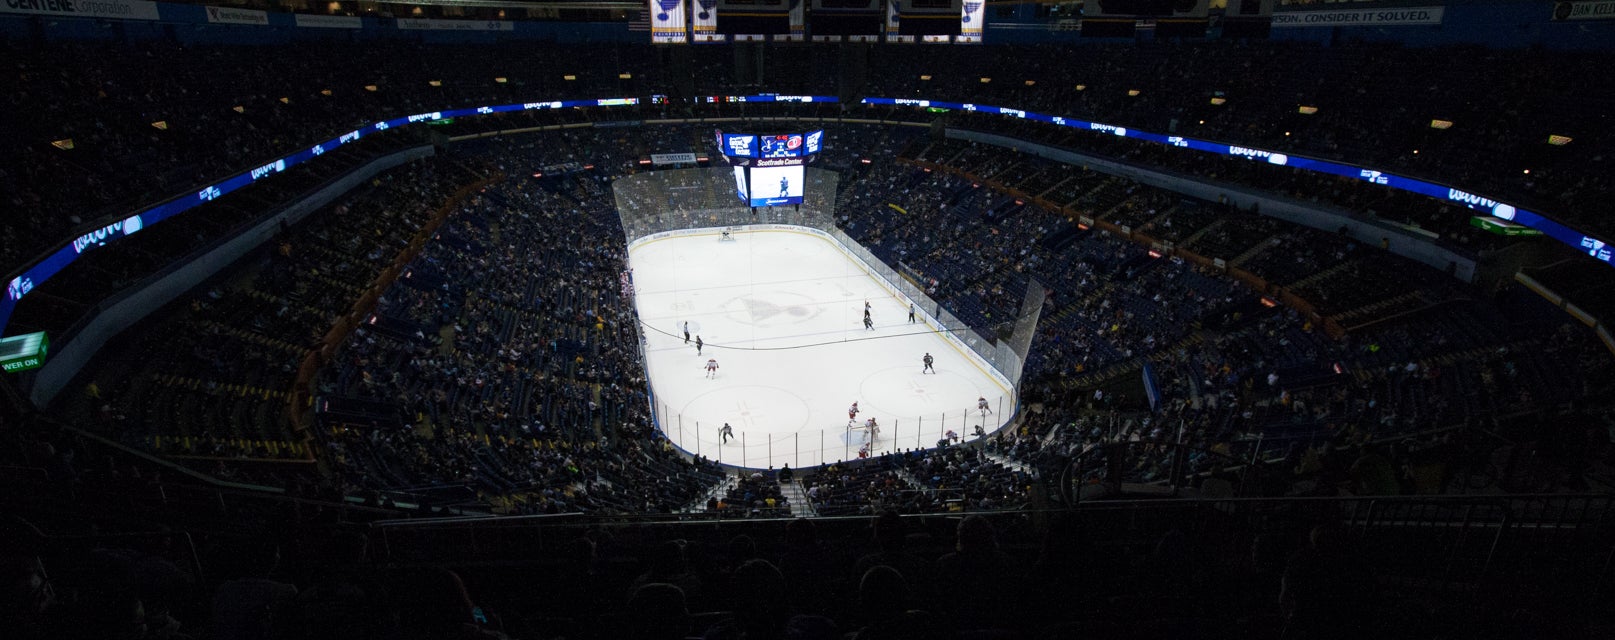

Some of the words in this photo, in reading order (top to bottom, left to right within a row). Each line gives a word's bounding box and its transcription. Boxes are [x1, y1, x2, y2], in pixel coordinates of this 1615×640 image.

[7, 0, 75, 11] CENTENE
[75, 0, 131, 15] Corporation
[1304, 13, 1359, 22] CONSIDER
[1363, 12, 1373, 21] IT
[1377, 11, 1430, 21] SOLVED.
[24, 358, 38, 367] ON
